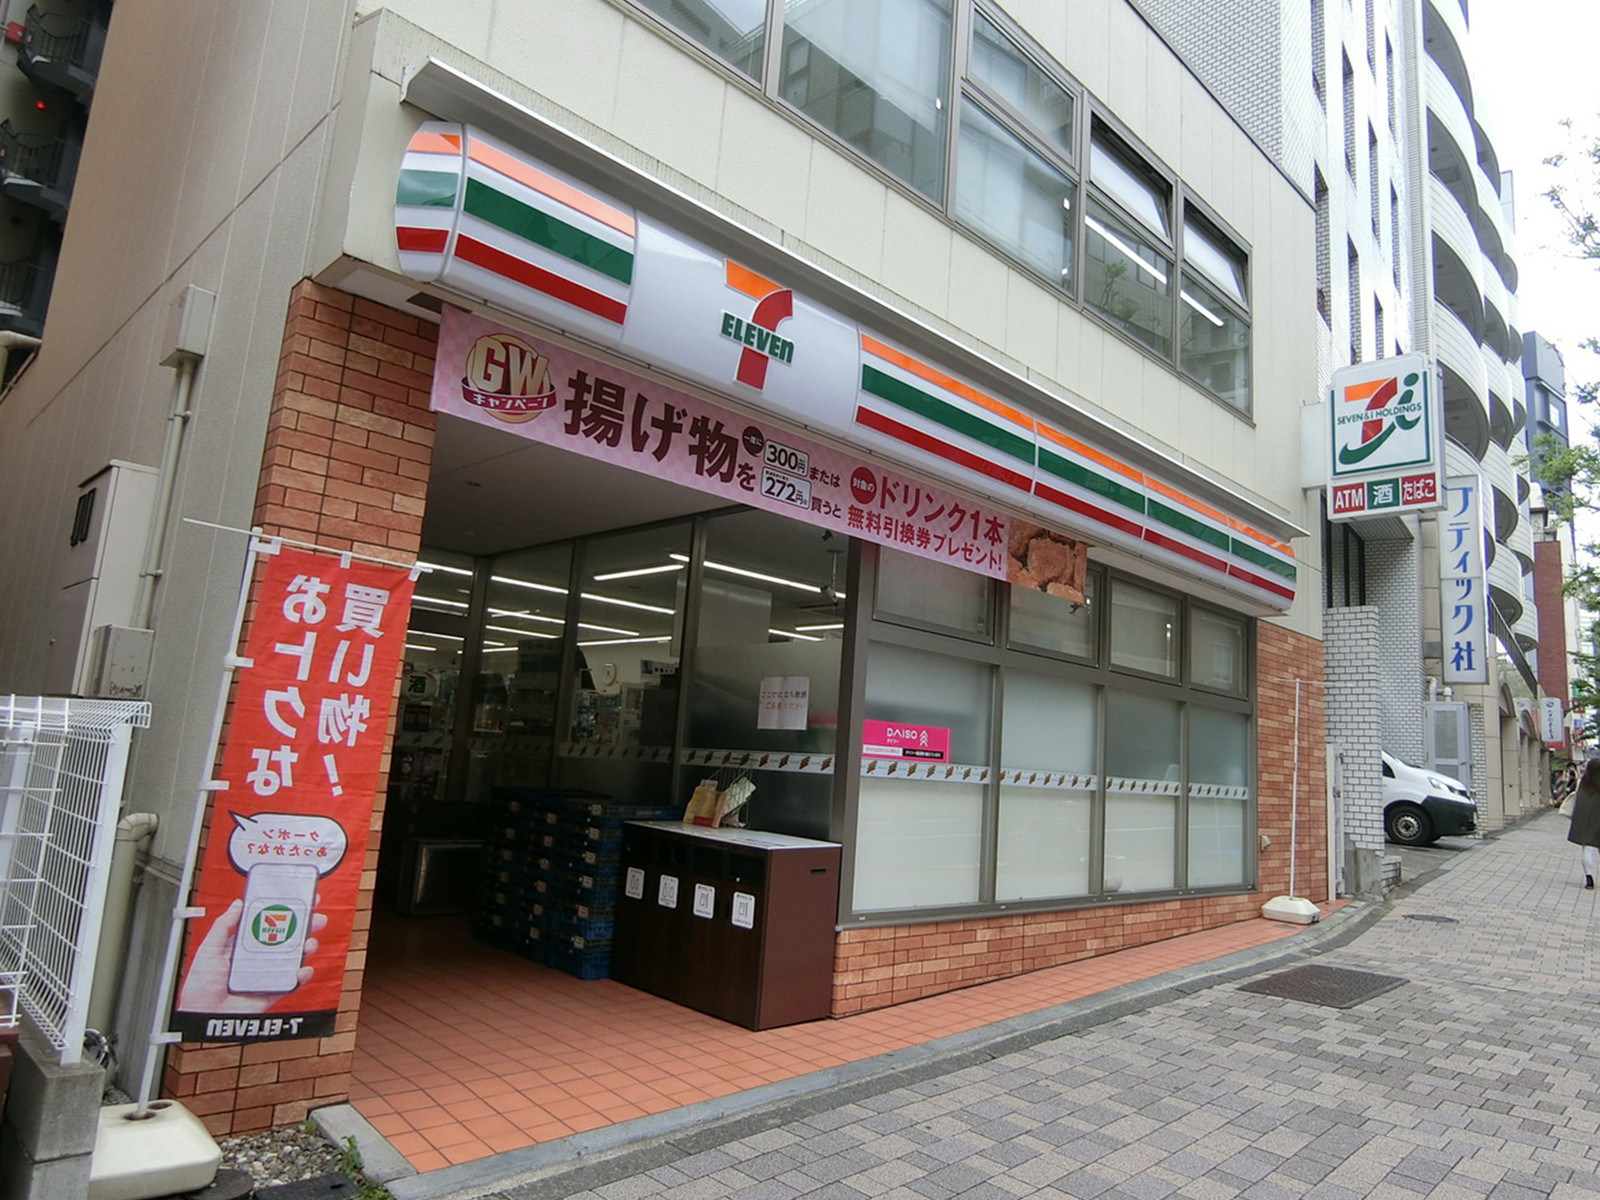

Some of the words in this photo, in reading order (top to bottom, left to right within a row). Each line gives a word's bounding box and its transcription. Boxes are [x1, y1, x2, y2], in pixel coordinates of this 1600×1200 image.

[721, 312, 794, 364] ELEVEN
[472, 336, 550, 396] GW
[473, 394, 548, 411] キャンペーン
[1376, 402, 1422, 418] HOLDINGS
[809, 466, 841, 488] または
[1335, 488, 1363, 509] ATM
[1373, 484, 1393, 505] 酒
[1403, 479, 1435, 501] たばこ
[810, 496, 842, 519] 買うと
[880, 475, 1005, 547] ドリンク1本
[408, 675, 427, 694] 酒
[887, 727, 918, 739] DAISO
